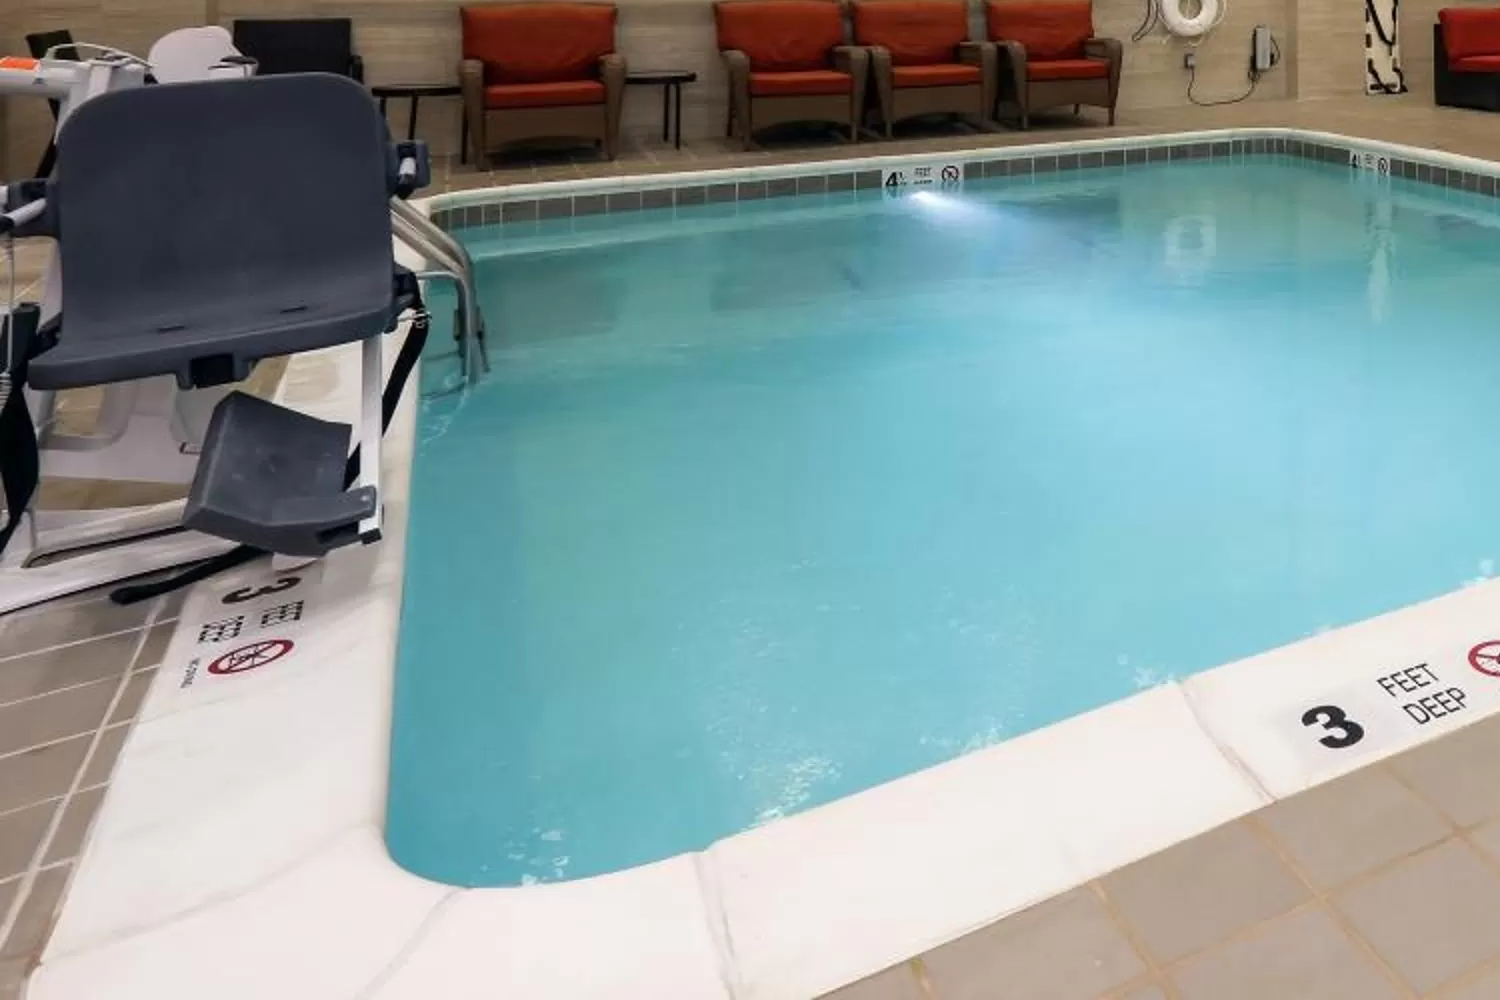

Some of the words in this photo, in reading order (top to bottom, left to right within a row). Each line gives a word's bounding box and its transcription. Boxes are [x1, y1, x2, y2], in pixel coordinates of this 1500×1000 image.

[222, 577, 302, 604] 3
[1377, 663, 1440, 697] FEET
[1402, 687, 1467, 725] DEEP
[1301, 705, 1365, 749] 3
